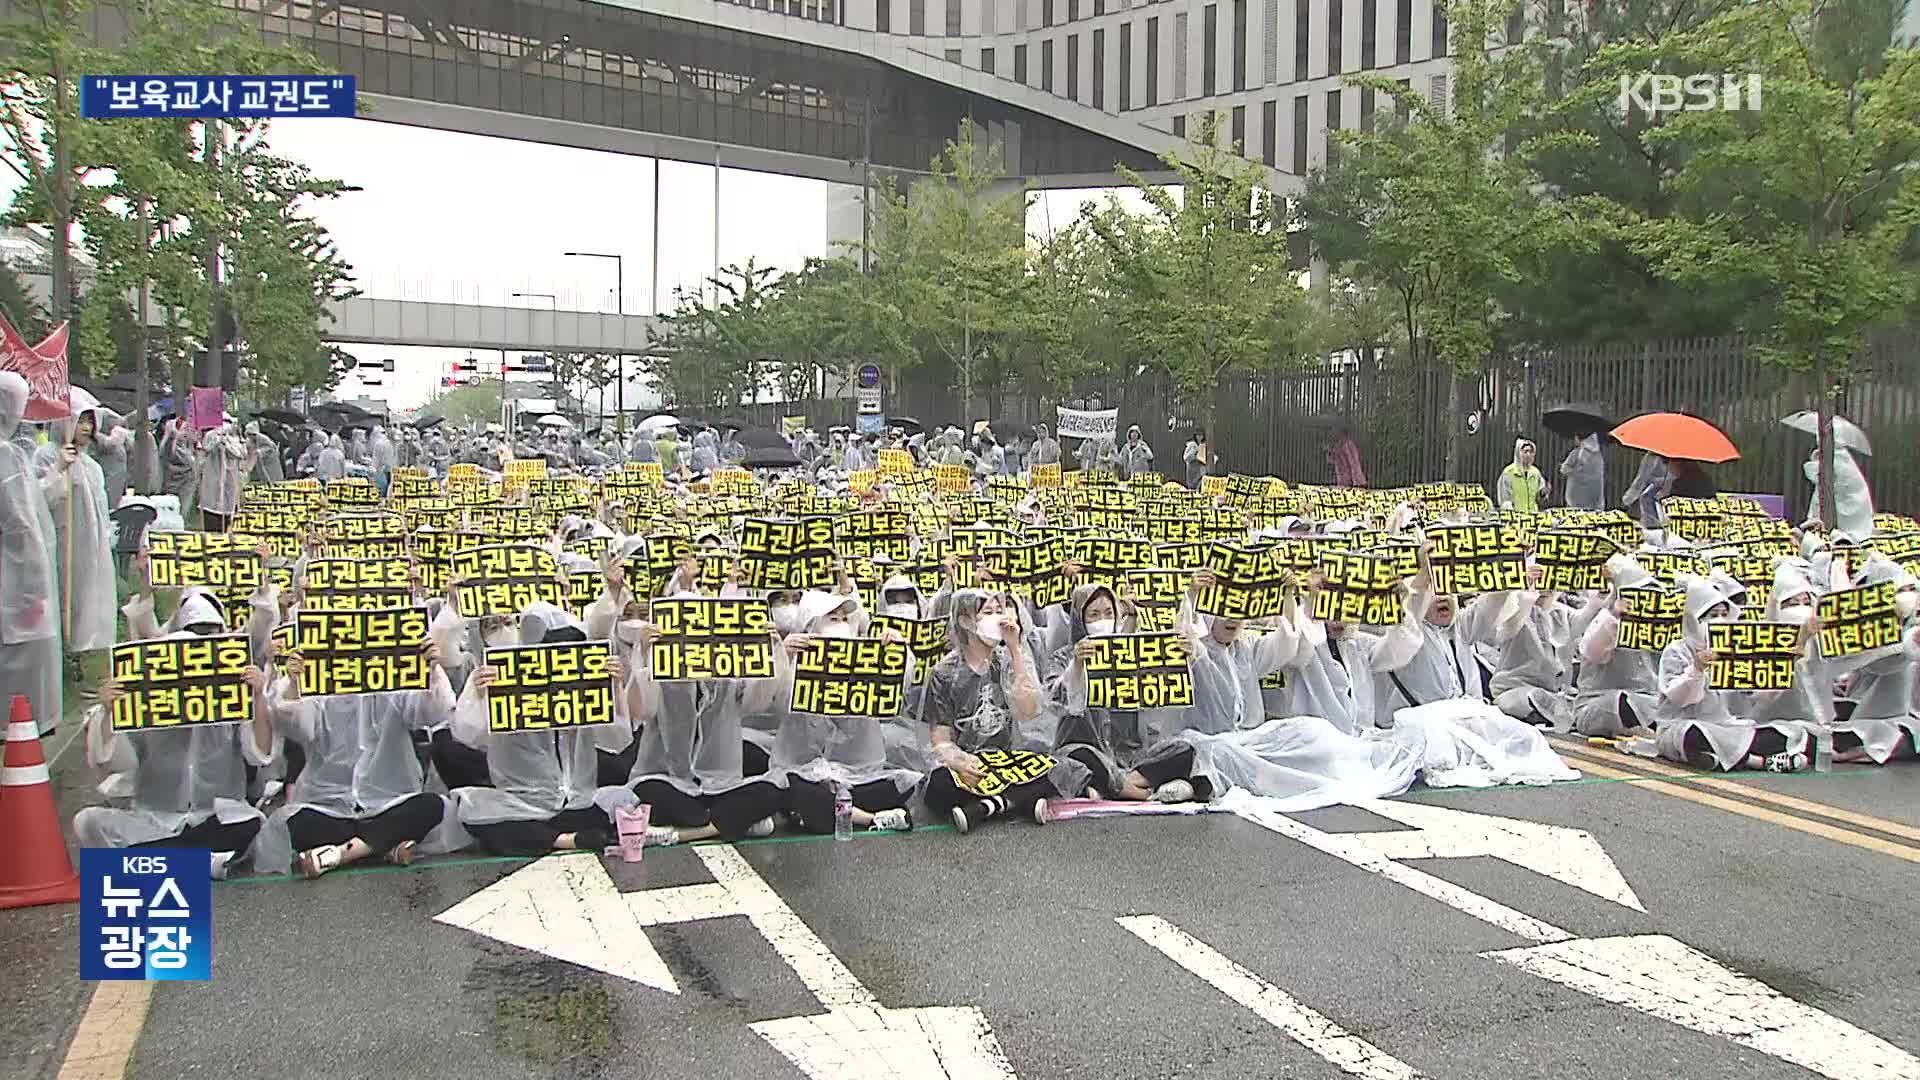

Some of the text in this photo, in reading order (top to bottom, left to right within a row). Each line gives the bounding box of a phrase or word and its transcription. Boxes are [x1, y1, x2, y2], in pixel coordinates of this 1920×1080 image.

[836, 512, 910, 537] 교권보호
[1427, 525, 1522, 558] 교권보호
[150, 556, 263, 586] 마련하라
[453, 548, 557, 579] 교권보호
[984, 541, 1066, 577] 교권보호
[1075, 541, 1152, 569] 교권보호
[308, 560, 412, 590] 교권보호
[1431, 559, 1527, 594] 마련하라
[1197, 583, 1285, 618] 마련하라
[1819, 582, 1897, 624] 교권보호
[300, 612, 426, 651] 교권보호
[654, 602, 769, 637] 교권보호
[1820, 616, 1900, 657] 마련하라
[798, 638, 906, 675] 교권보호
[1088, 637, 1190, 671] 교권보호
[1709, 625, 1797, 654] 교권보호
[112, 640, 249, 683] 교권보호
[301, 654, 429, 694] 마련하라
[487, 647, 611, 688] 교권보호
[654, 641, 774, 678] 마련하라
[1709, 656, 1795, 689] 마련하라
[112, 683, 253, 728] 마련하라
[489, 687, 614, 730] 마련하라
[793, 678, 902, 715] 마련하라
[1087, 673, 1193, 709] 마련하라
